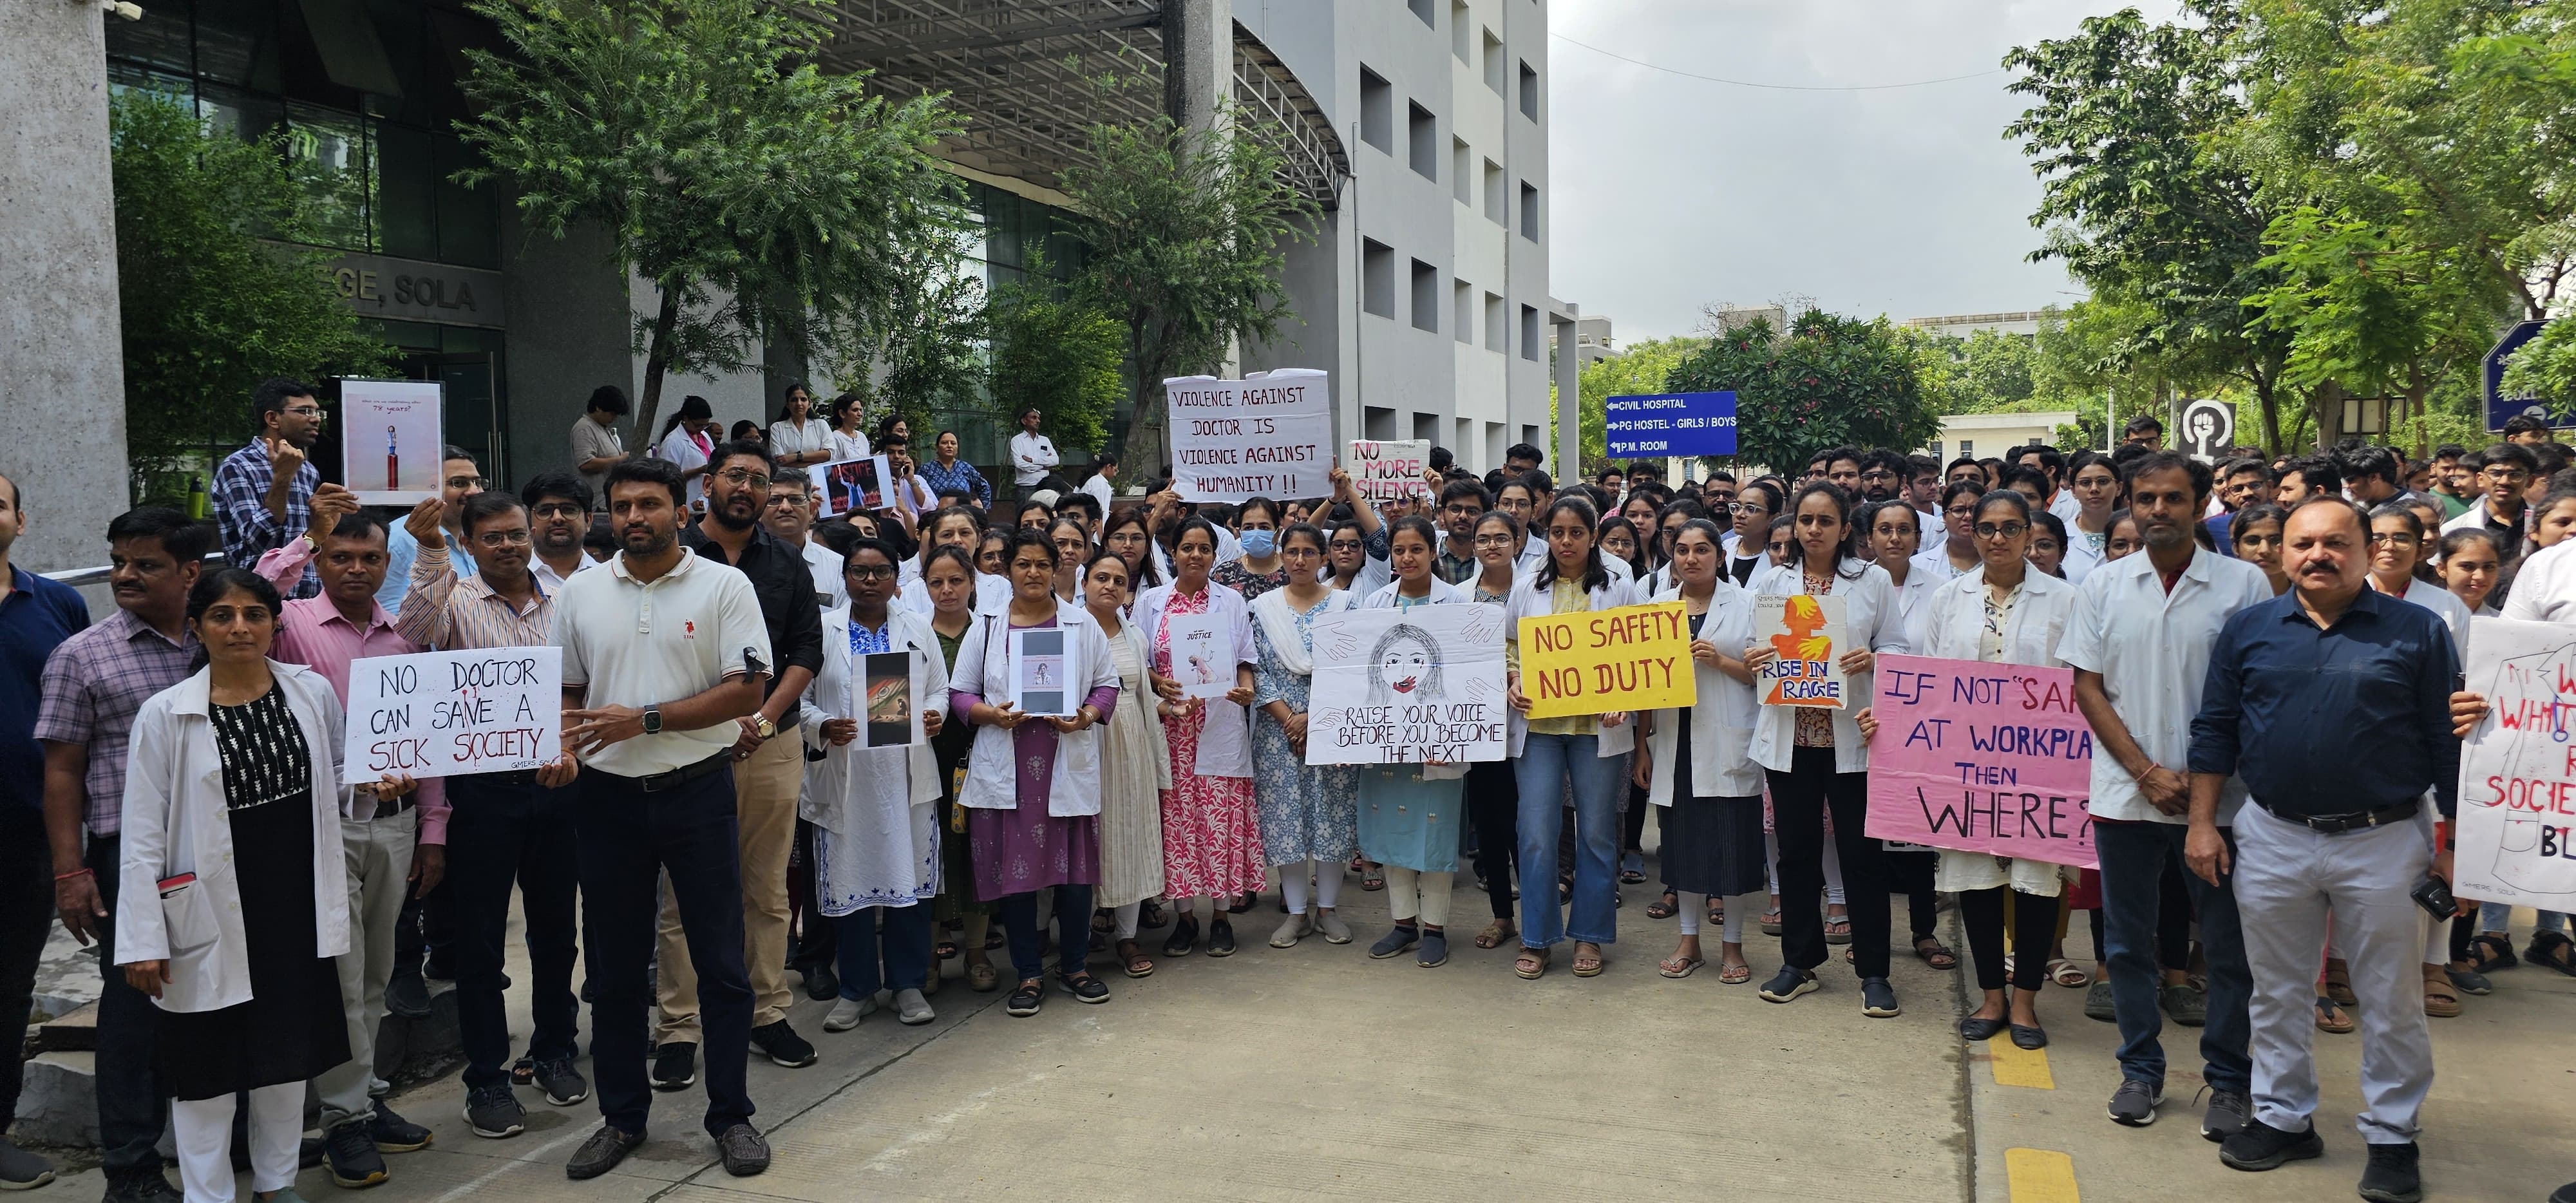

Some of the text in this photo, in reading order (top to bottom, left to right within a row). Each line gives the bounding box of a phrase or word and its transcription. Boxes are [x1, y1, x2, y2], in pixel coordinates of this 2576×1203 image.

[394, 274, 477, 312] SOLA
[1173, 386, 1305, 407] VIOLENCE AGAINST
[1619, 399, 1687, 410] CIVIL HOSPITAL
[387, 406, 411, 414] years?
[1192, 419, 1274, 436] DOCTOR IS
[1619, 421, 1632, 430] PG
[1634, 420, 1670, 430] HOSTEL
[1677, 418, 1704, 428] GIRLS
[1711, 417, 1737, 427] BOYS
[1179, 444, 1316, 465] VIOLENCE AGAINST
[1354, 442, 1380, 460] NO
[1621, 440, 1667, 451] P.M. ROOM
[1365, 459, 1420, 479] MORE
[1197, 474, 1296, 494] HUMANITY !!
[1187, 632, 1212, 640] JUSTICE
[1535, 610, 1683, 653] NO SAFETY
[381, 659, 538, 697] NO DOCTOR
[1539, 657, 1675, 699] NO DUTY
[1762, 660, 1829, 678] RISE IN
[1783, 680, 1839, 699] RAGE
[1884, 669, 1936, 705] IF
[1953, 676, 2009, 705] NOT
[371, 694, 534, 734] CAN SAVE A
[1345, 704, 1486, 728] RAISE YOUR VOICE
[1334, 724, 1504, 747] BEFORE YOU BECOME
[1905, 719, 1951, 751] AT
[368, 728, 544, 770] SICK SOCIETY
[1379, 744, 1470, 763] THE NEXT
[1955, 763, 2016, 786] THEN
[1917, 786, 2090, 846] WHERE?
